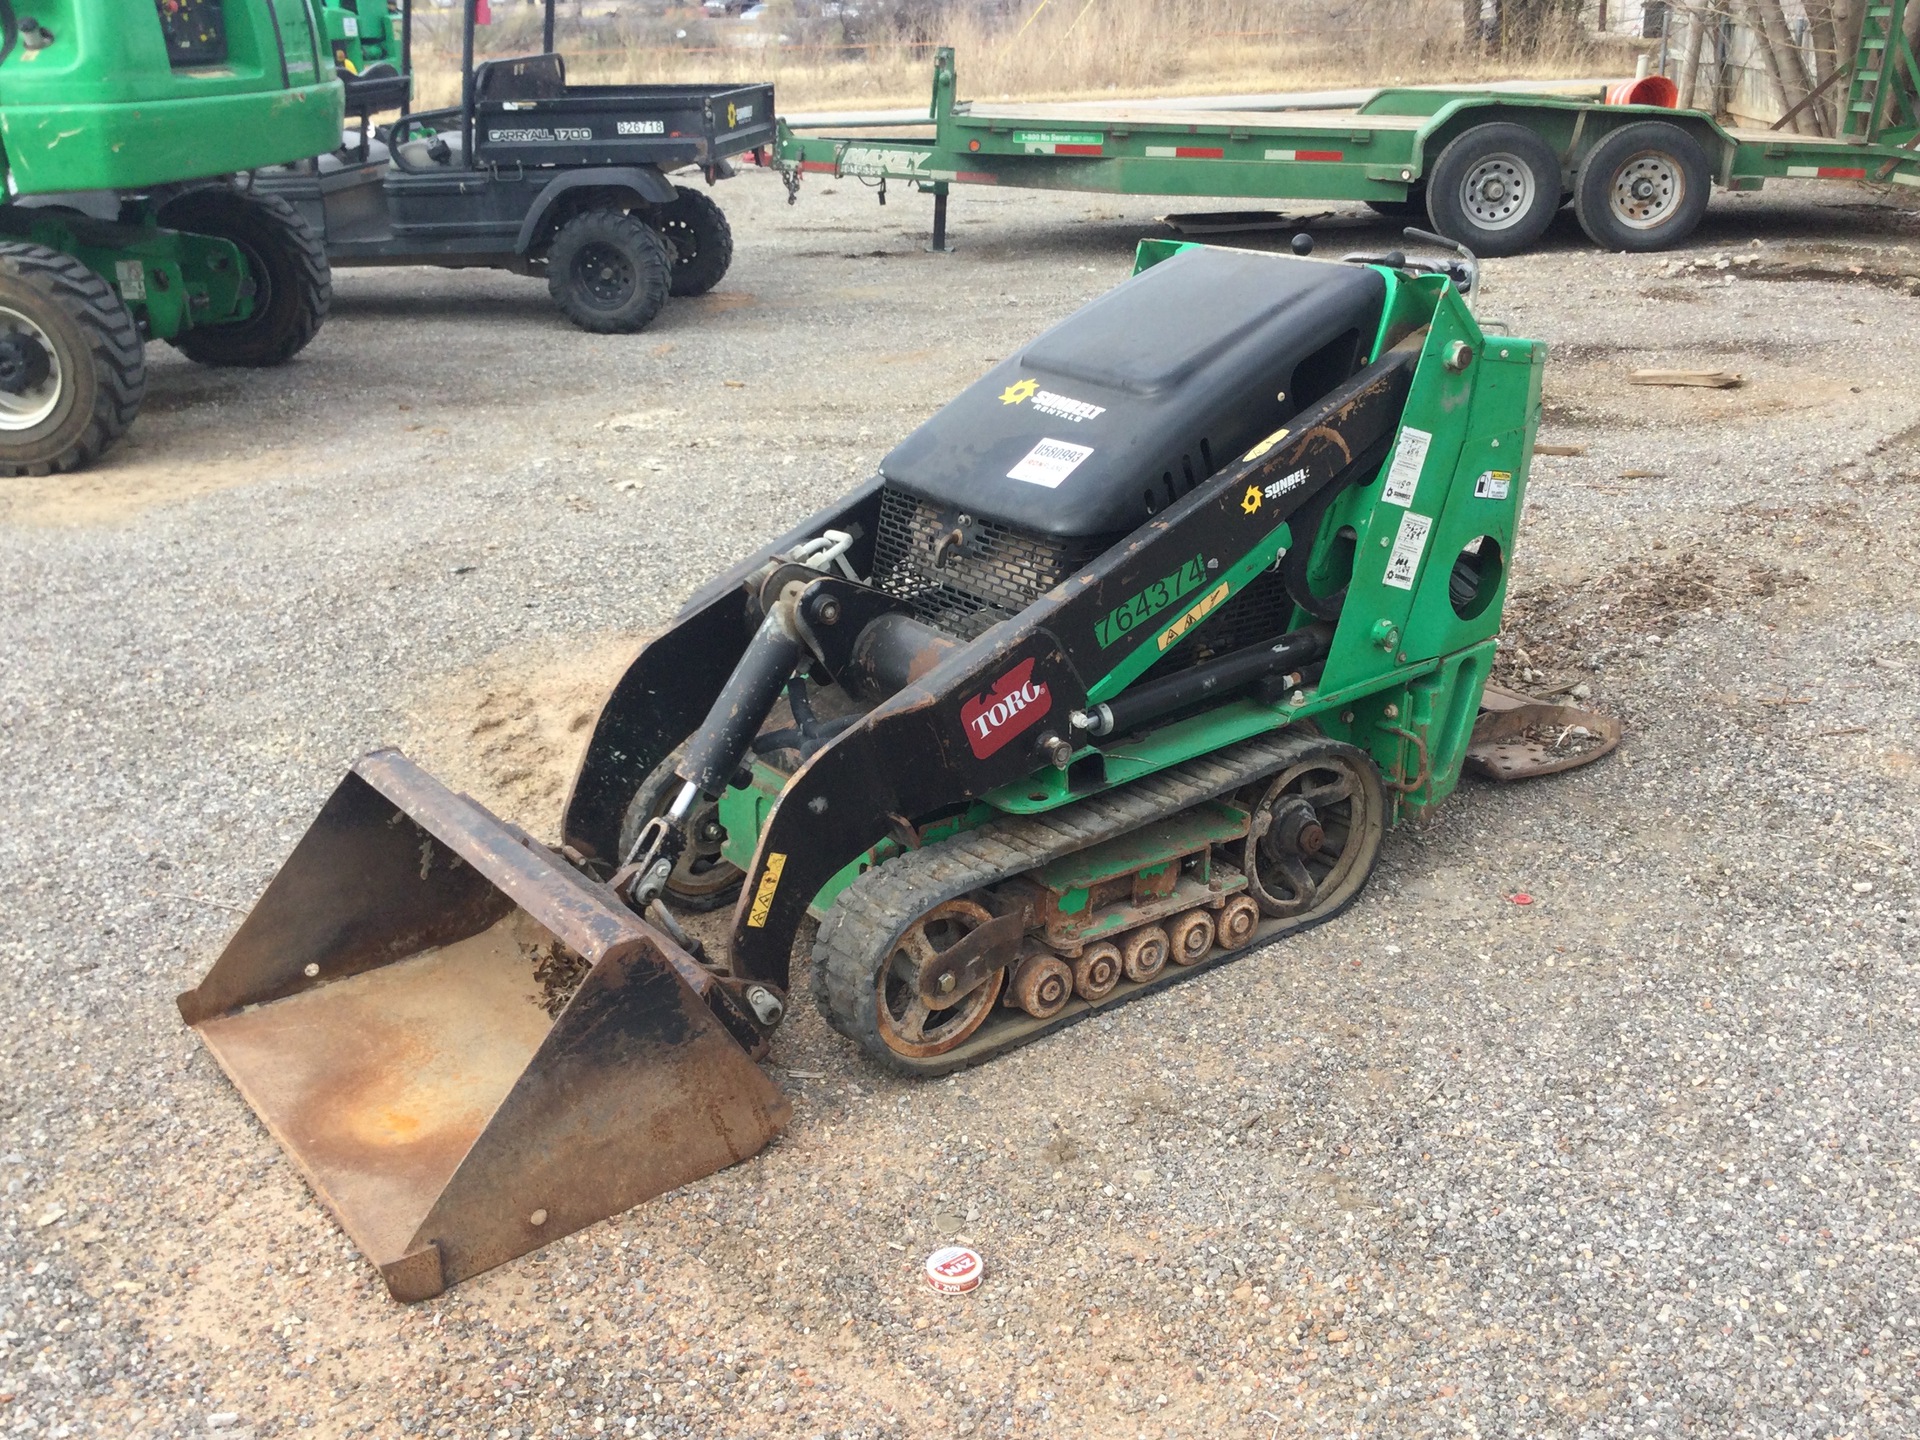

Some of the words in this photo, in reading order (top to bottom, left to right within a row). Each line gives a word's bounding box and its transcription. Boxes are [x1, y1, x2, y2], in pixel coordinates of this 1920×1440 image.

[488, 130, 554, 142] CARRYALL
[554, 128, 592, 140] 1700
[618, 122, 664, 134] 826718
[842, 148, 932, 175] MAXEY
[1031, 390, 1106, 420] SUNBELT
[1033, 403, 1083, 423] RENTALS
[1034, 444, 1084, 463] U580993
[1272, 479, 1306, 500] RENTAS
[1095, 556, 1206, 646] 764374
[943, 1257, 976, 1277] ZYN
[942, 1284, 961, 1292] ZYN
